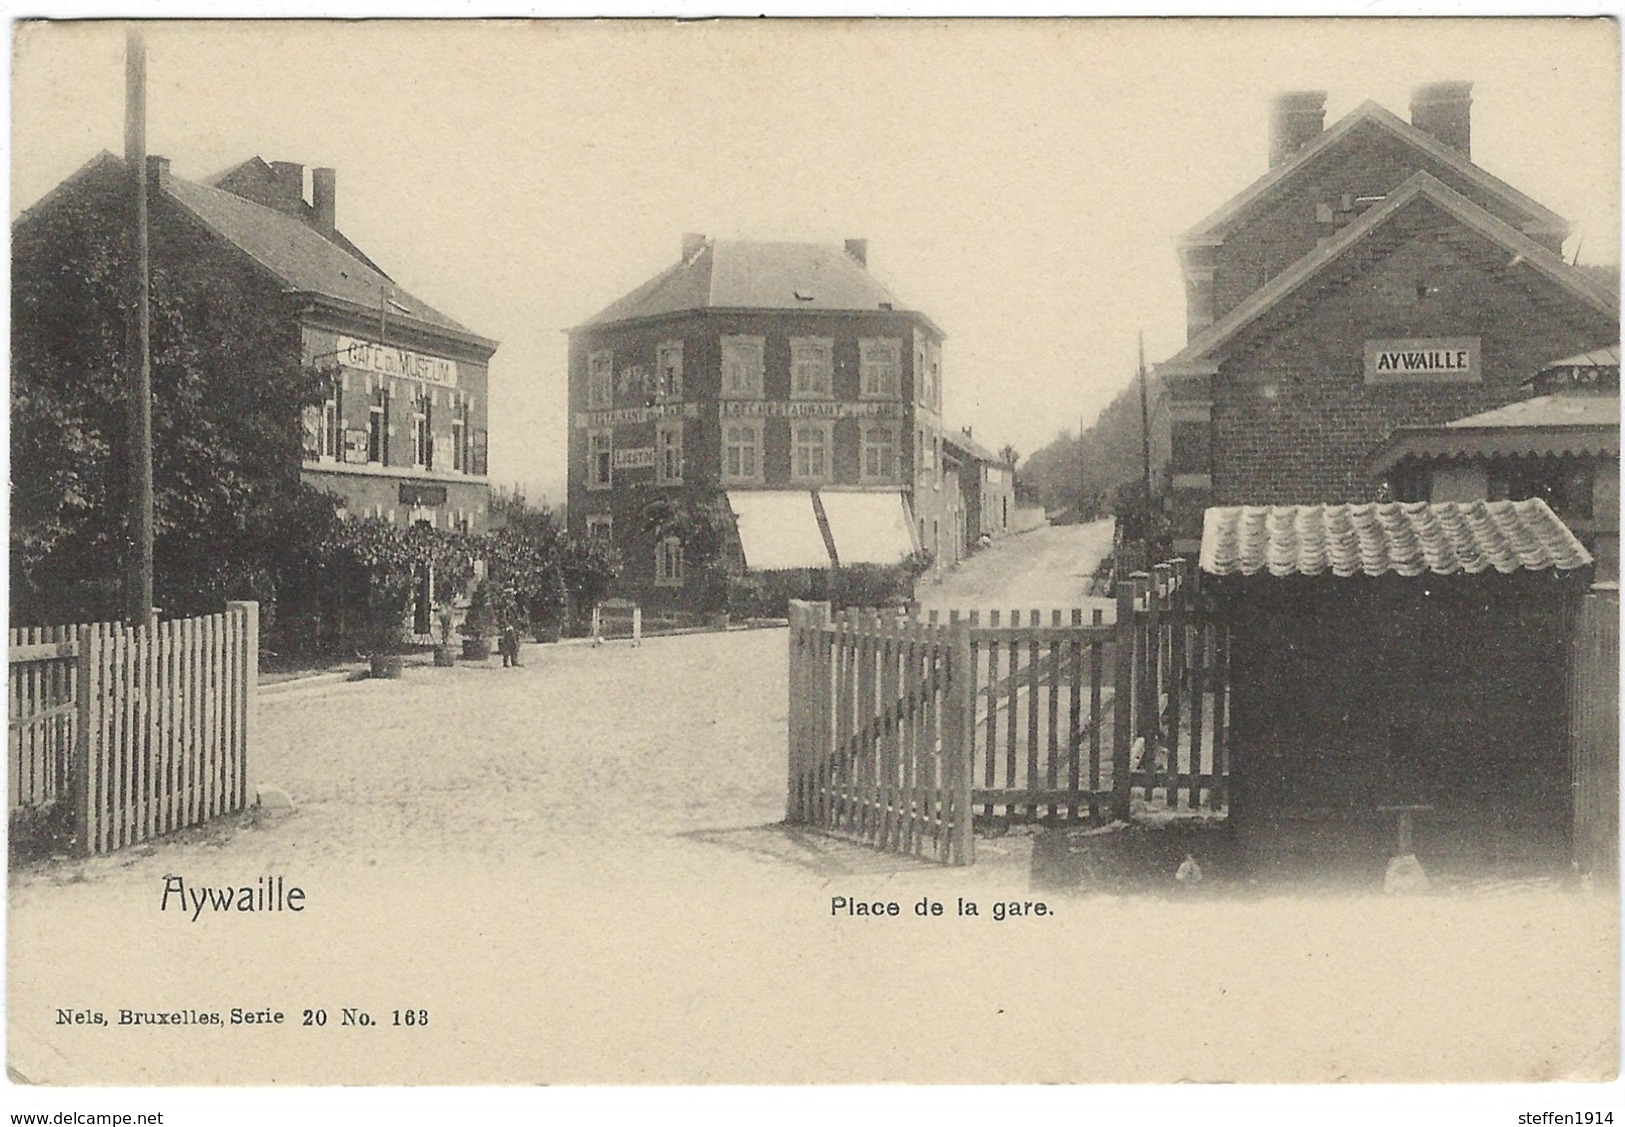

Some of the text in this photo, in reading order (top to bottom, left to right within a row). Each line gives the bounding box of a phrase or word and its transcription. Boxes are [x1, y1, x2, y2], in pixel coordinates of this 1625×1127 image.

[398, 350, 450, 382] MUSEUM
[1378, 351, 1467, 370] AYWAILLE
[161, 876, 306, 922] Aywaille
[831, 896, 1054, 921] Place de la gare.
[55, 1008, 429, 1027] Nels, Bruxelles, Serie 20 No. 163
